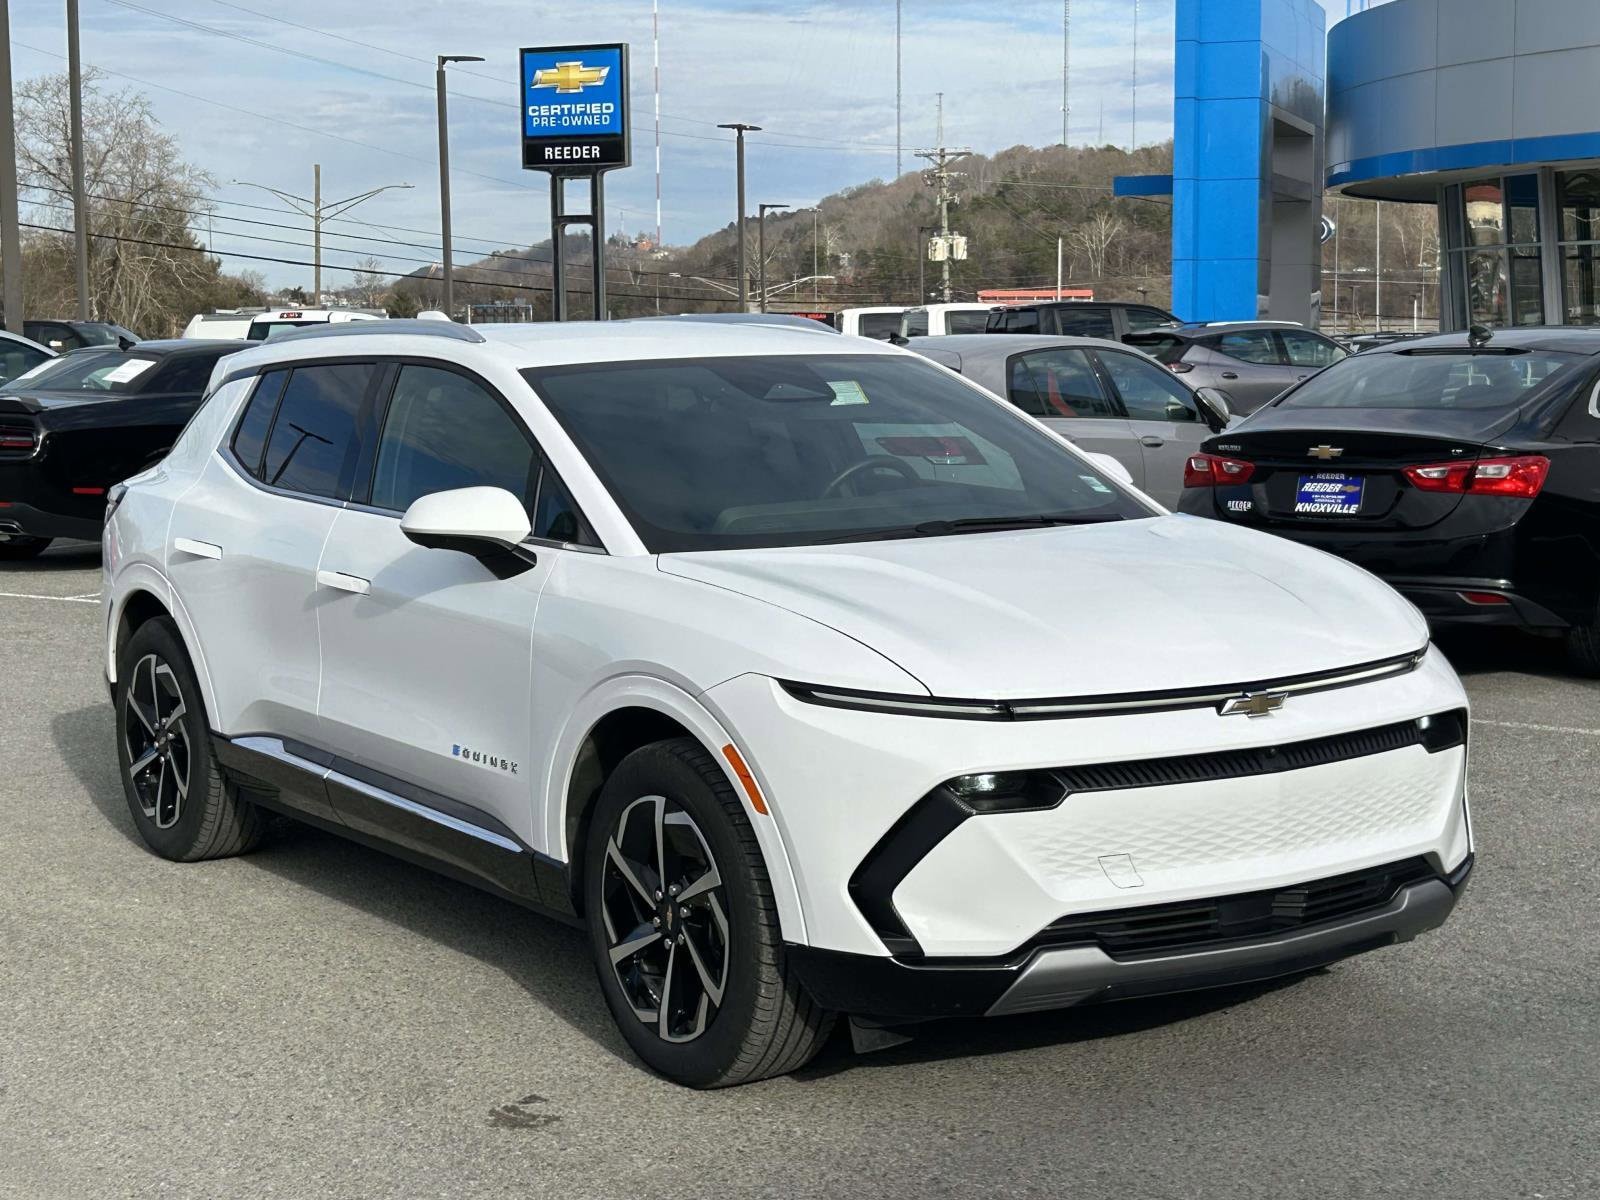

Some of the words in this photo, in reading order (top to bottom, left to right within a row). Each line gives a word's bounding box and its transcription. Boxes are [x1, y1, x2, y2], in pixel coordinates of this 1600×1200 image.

[528, 102, 615, 116] CERTIFIED
[532, 114, 610, 127] PRE-OWNED
[544, 145, 600, 160] REEDER
[1301, 482, 1343, 492] REEDER
[1294, 502, 1359, 514] KNOXVILLE
